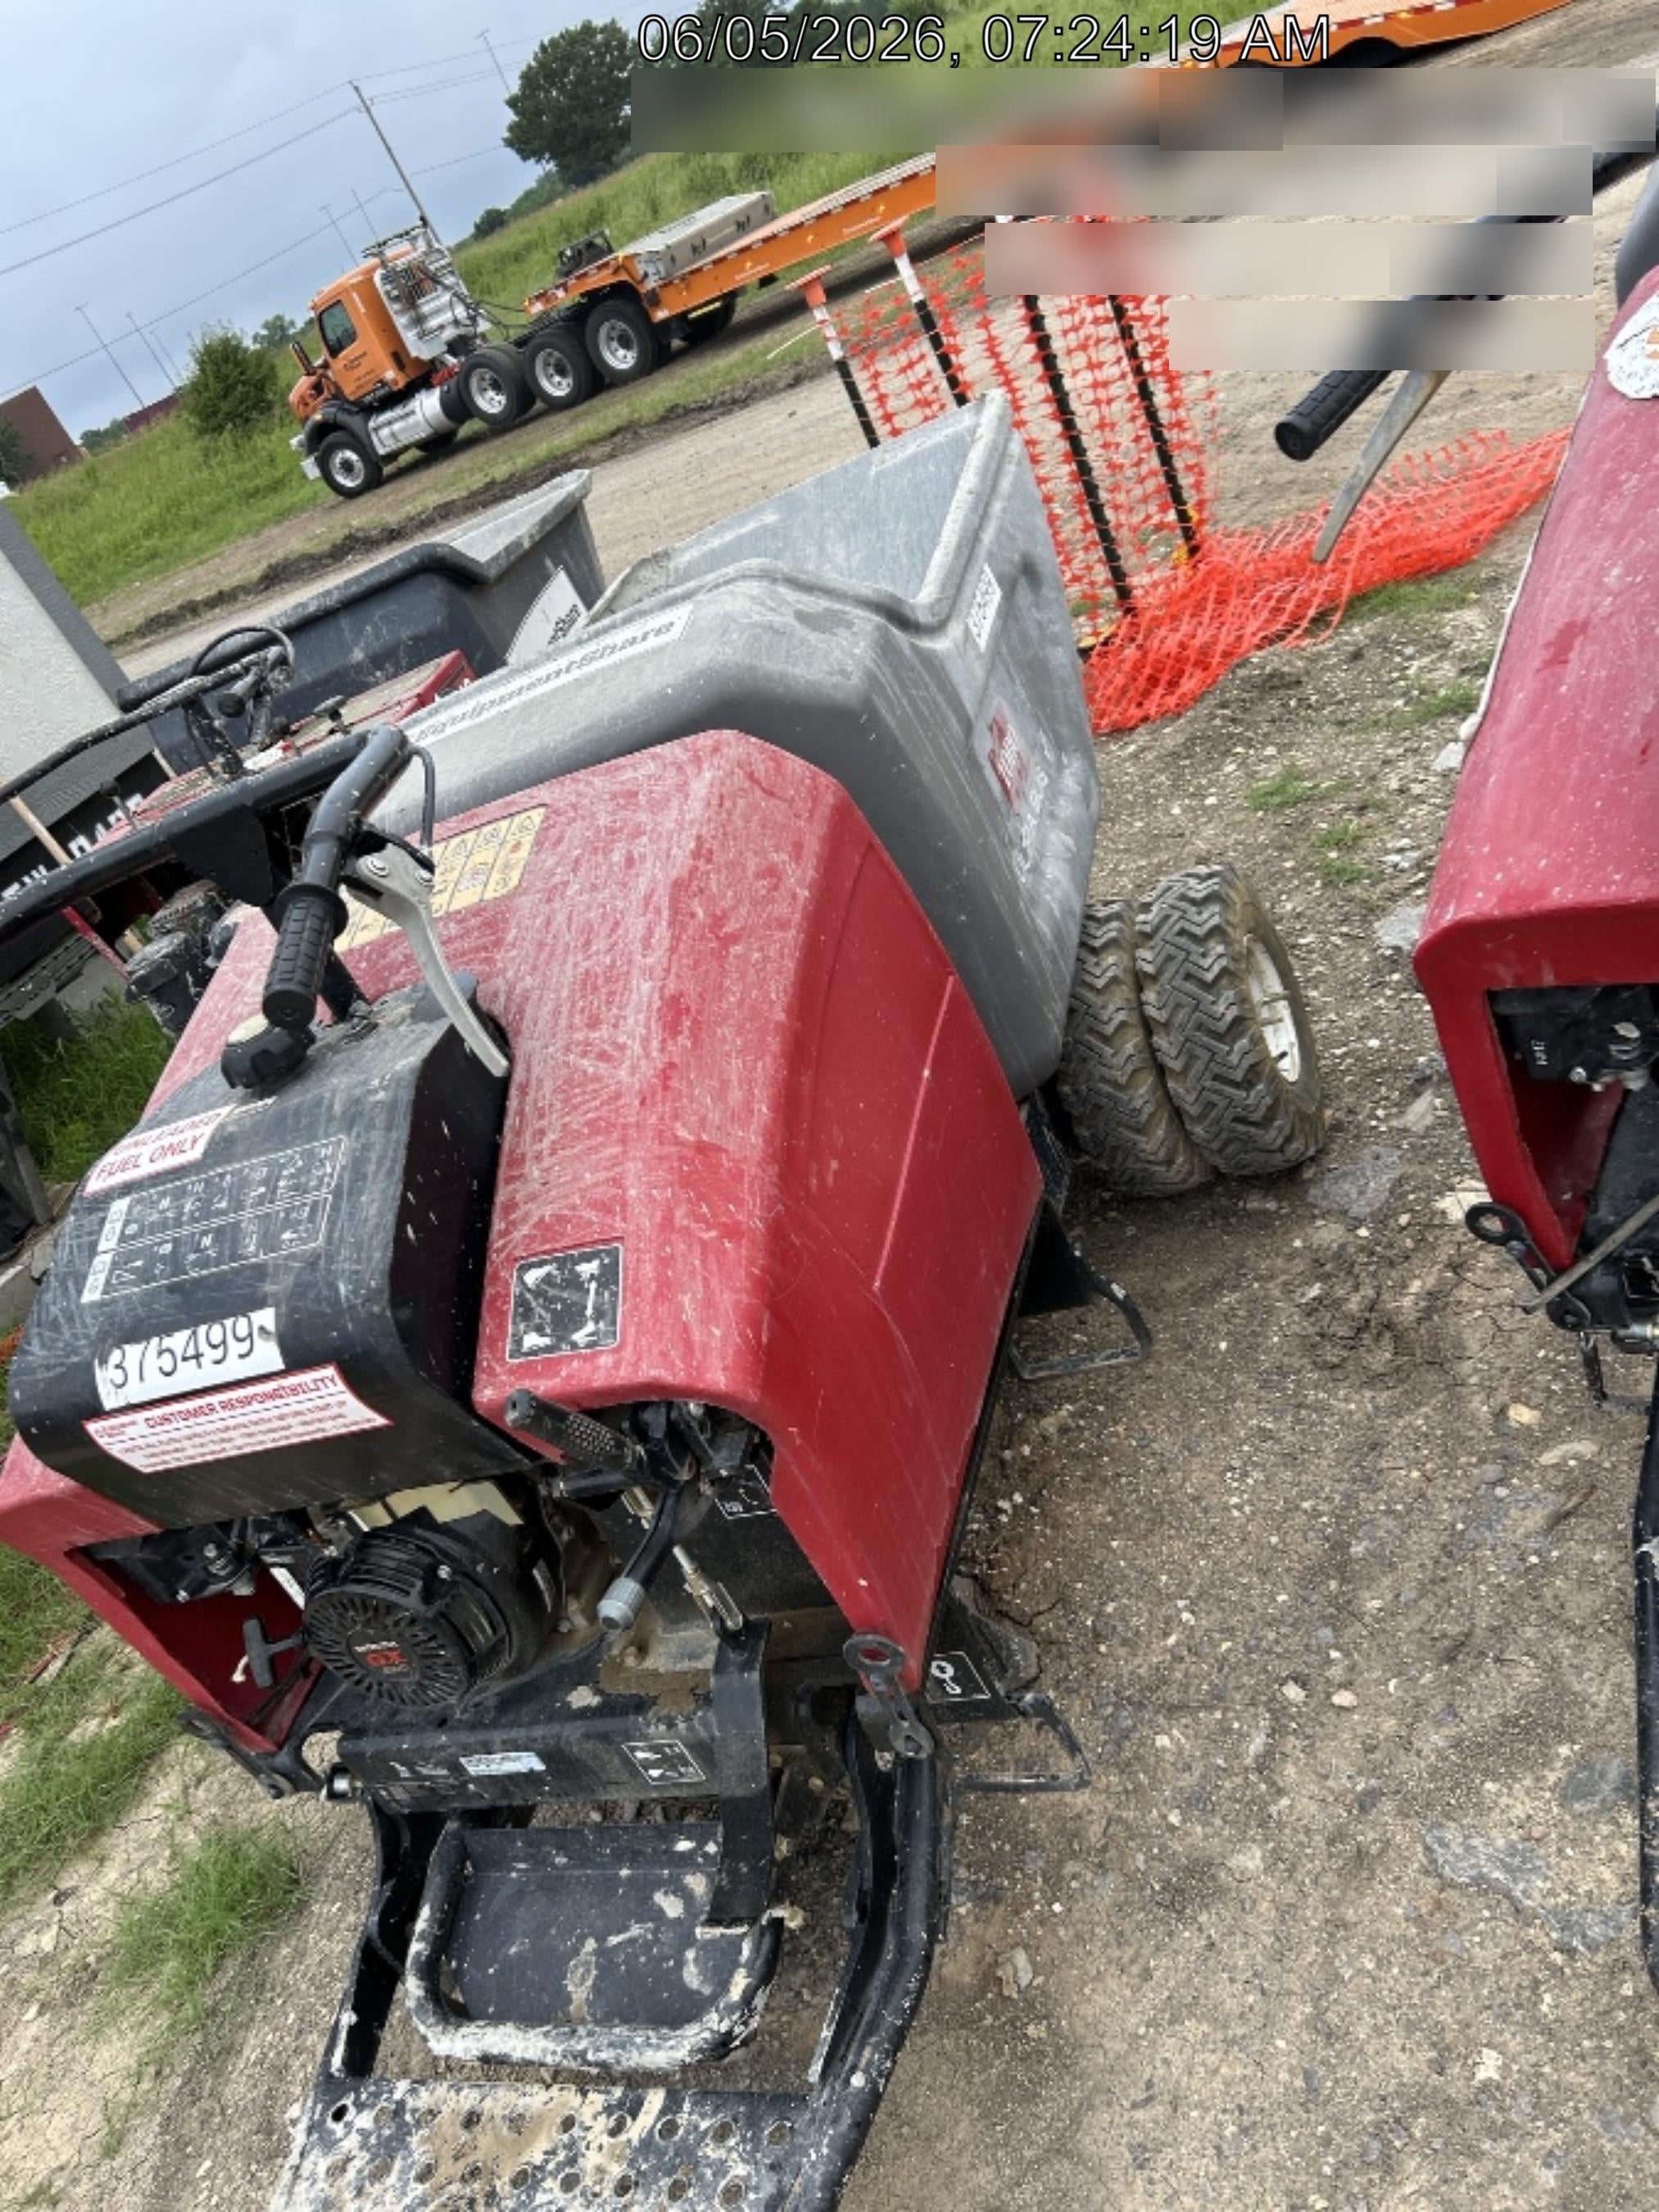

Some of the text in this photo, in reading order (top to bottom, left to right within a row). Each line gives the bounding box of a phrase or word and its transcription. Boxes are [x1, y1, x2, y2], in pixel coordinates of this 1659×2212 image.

[95, 1132, 205, 1183] FUEL ONLY
[109, 1313, 256, 1389] 375499
[143, 1403, 216, 1430] CUSTOMER
[220, 1373, 338, 1412] RESPONSIBILITY
